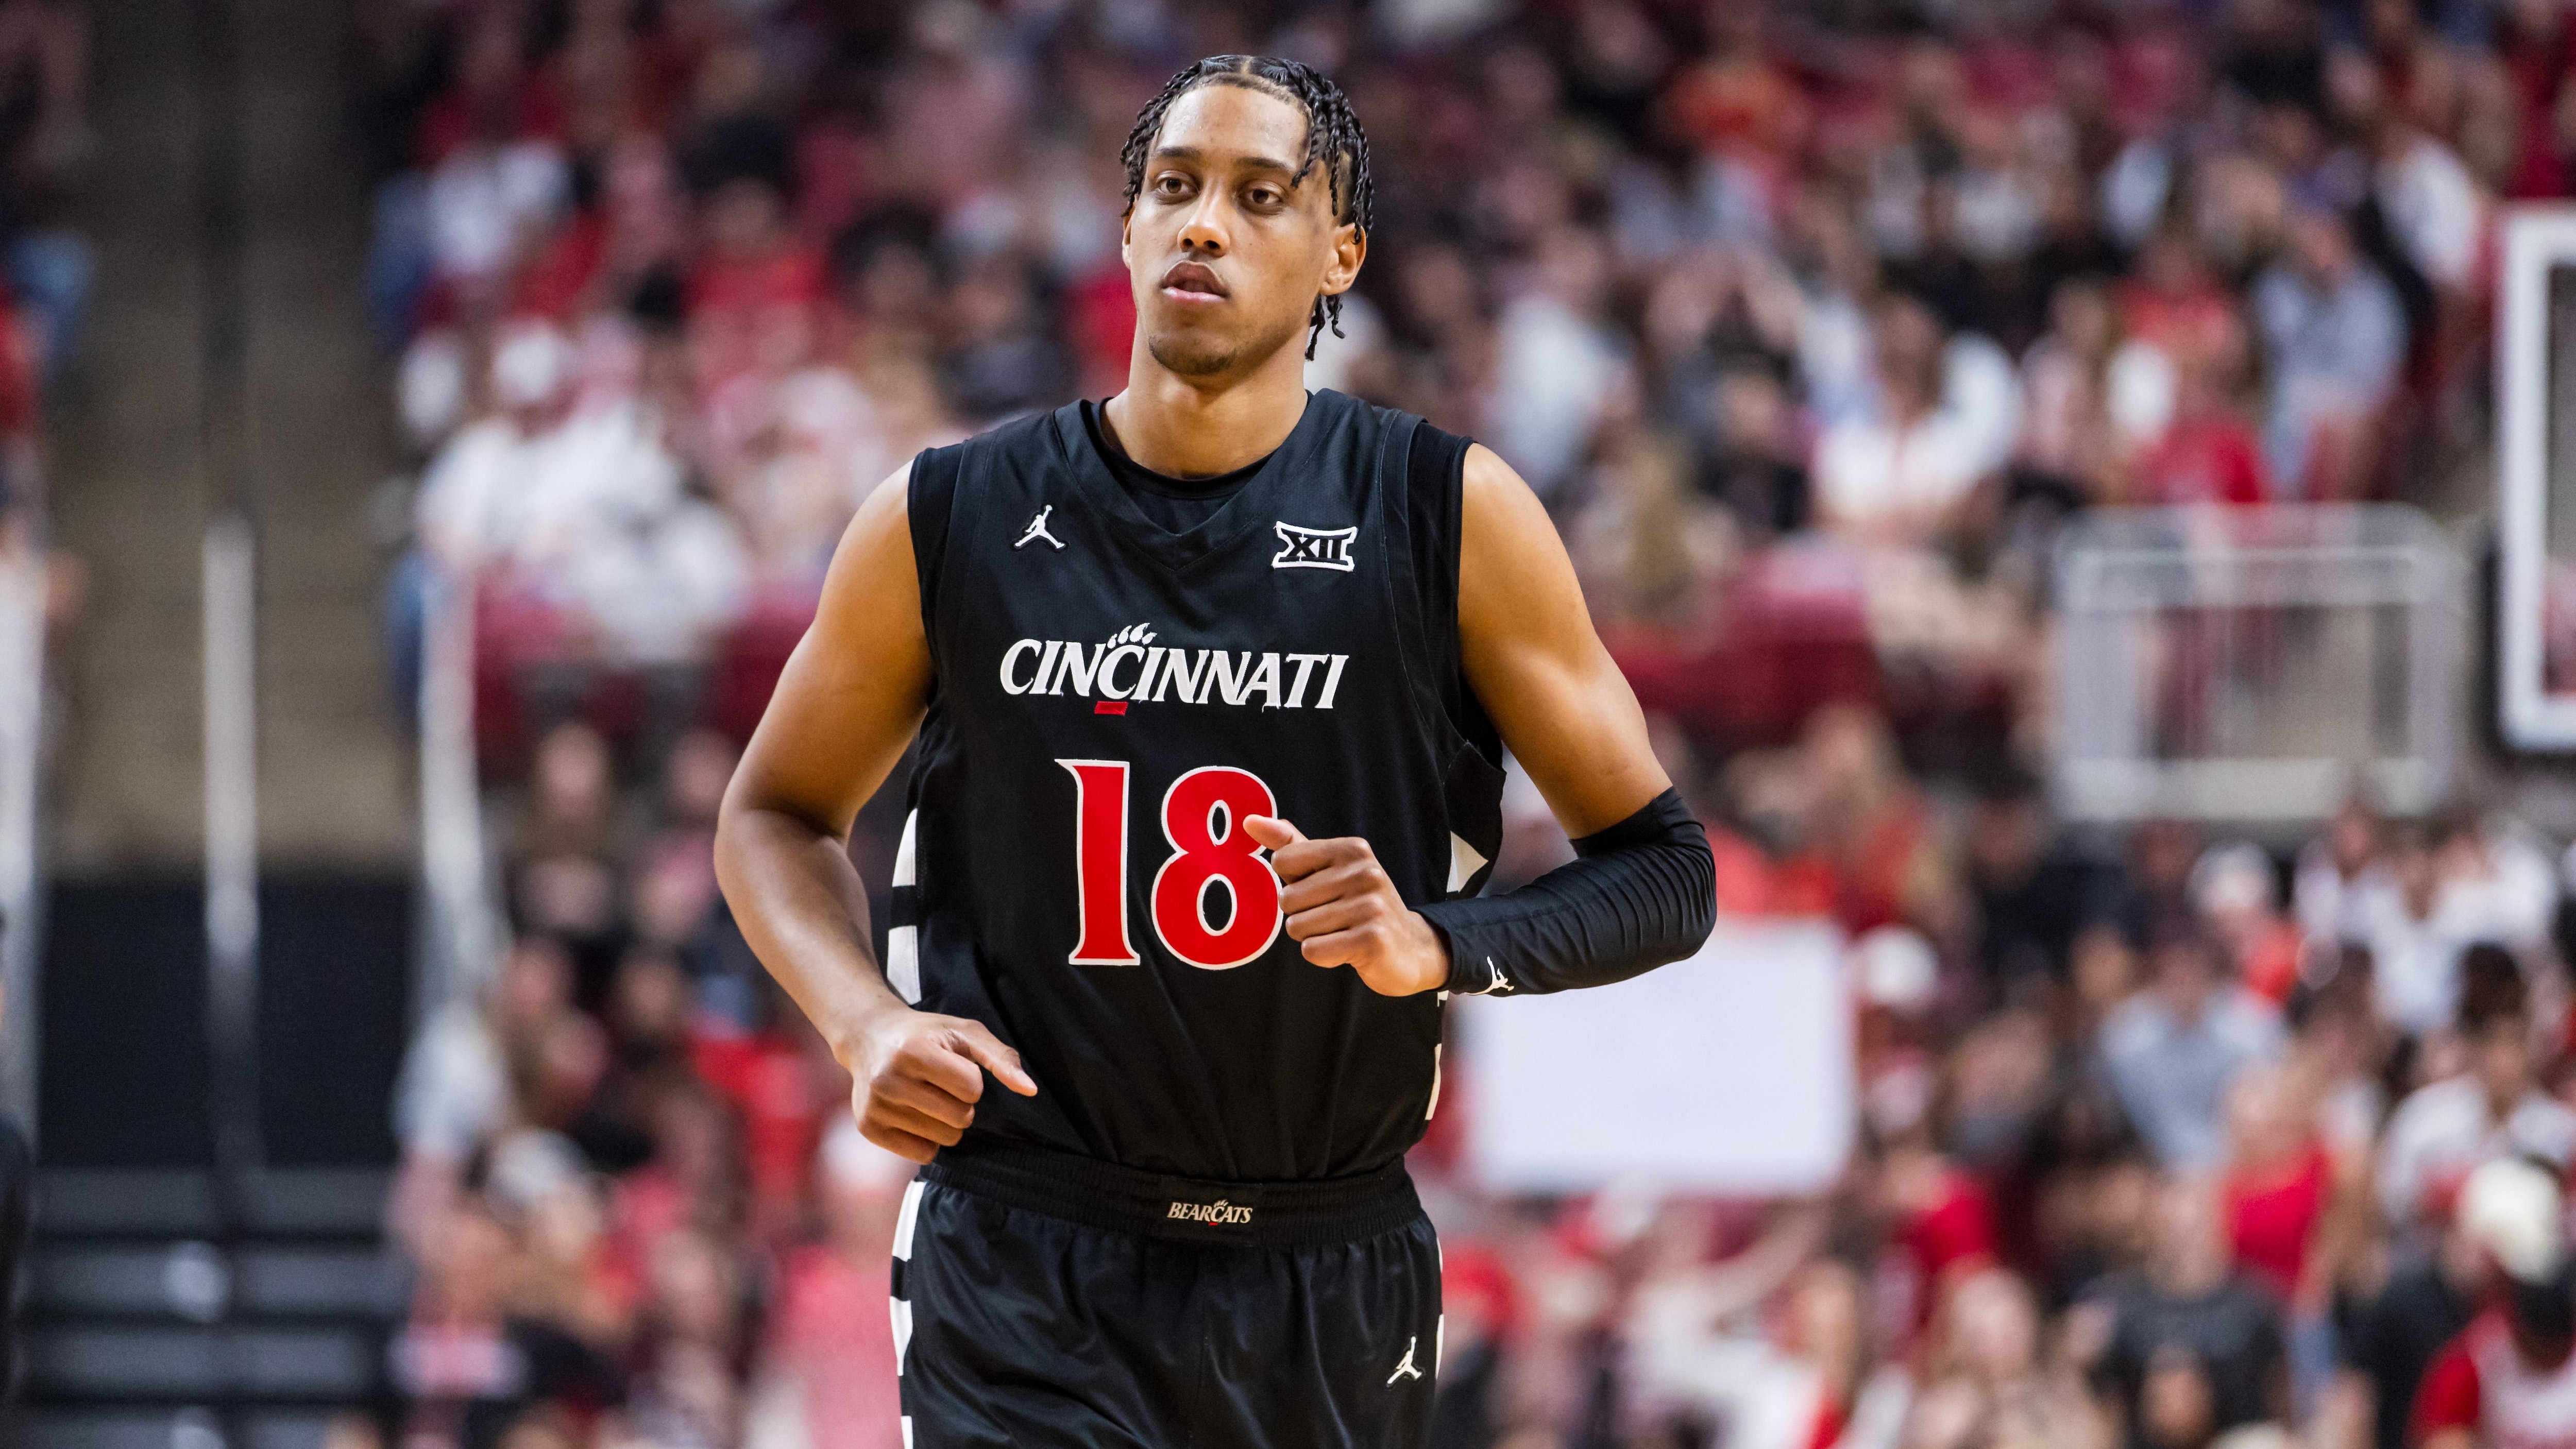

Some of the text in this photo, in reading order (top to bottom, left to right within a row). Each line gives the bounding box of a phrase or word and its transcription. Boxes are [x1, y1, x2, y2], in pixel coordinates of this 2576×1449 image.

[1278, 526, 1353, 567] XII
[1000, 638, 1349, 710] CINCINNATI
[1055, 758, 1283, 970] 18
[1166, 1201, 1253, 1224] BEARCATS
